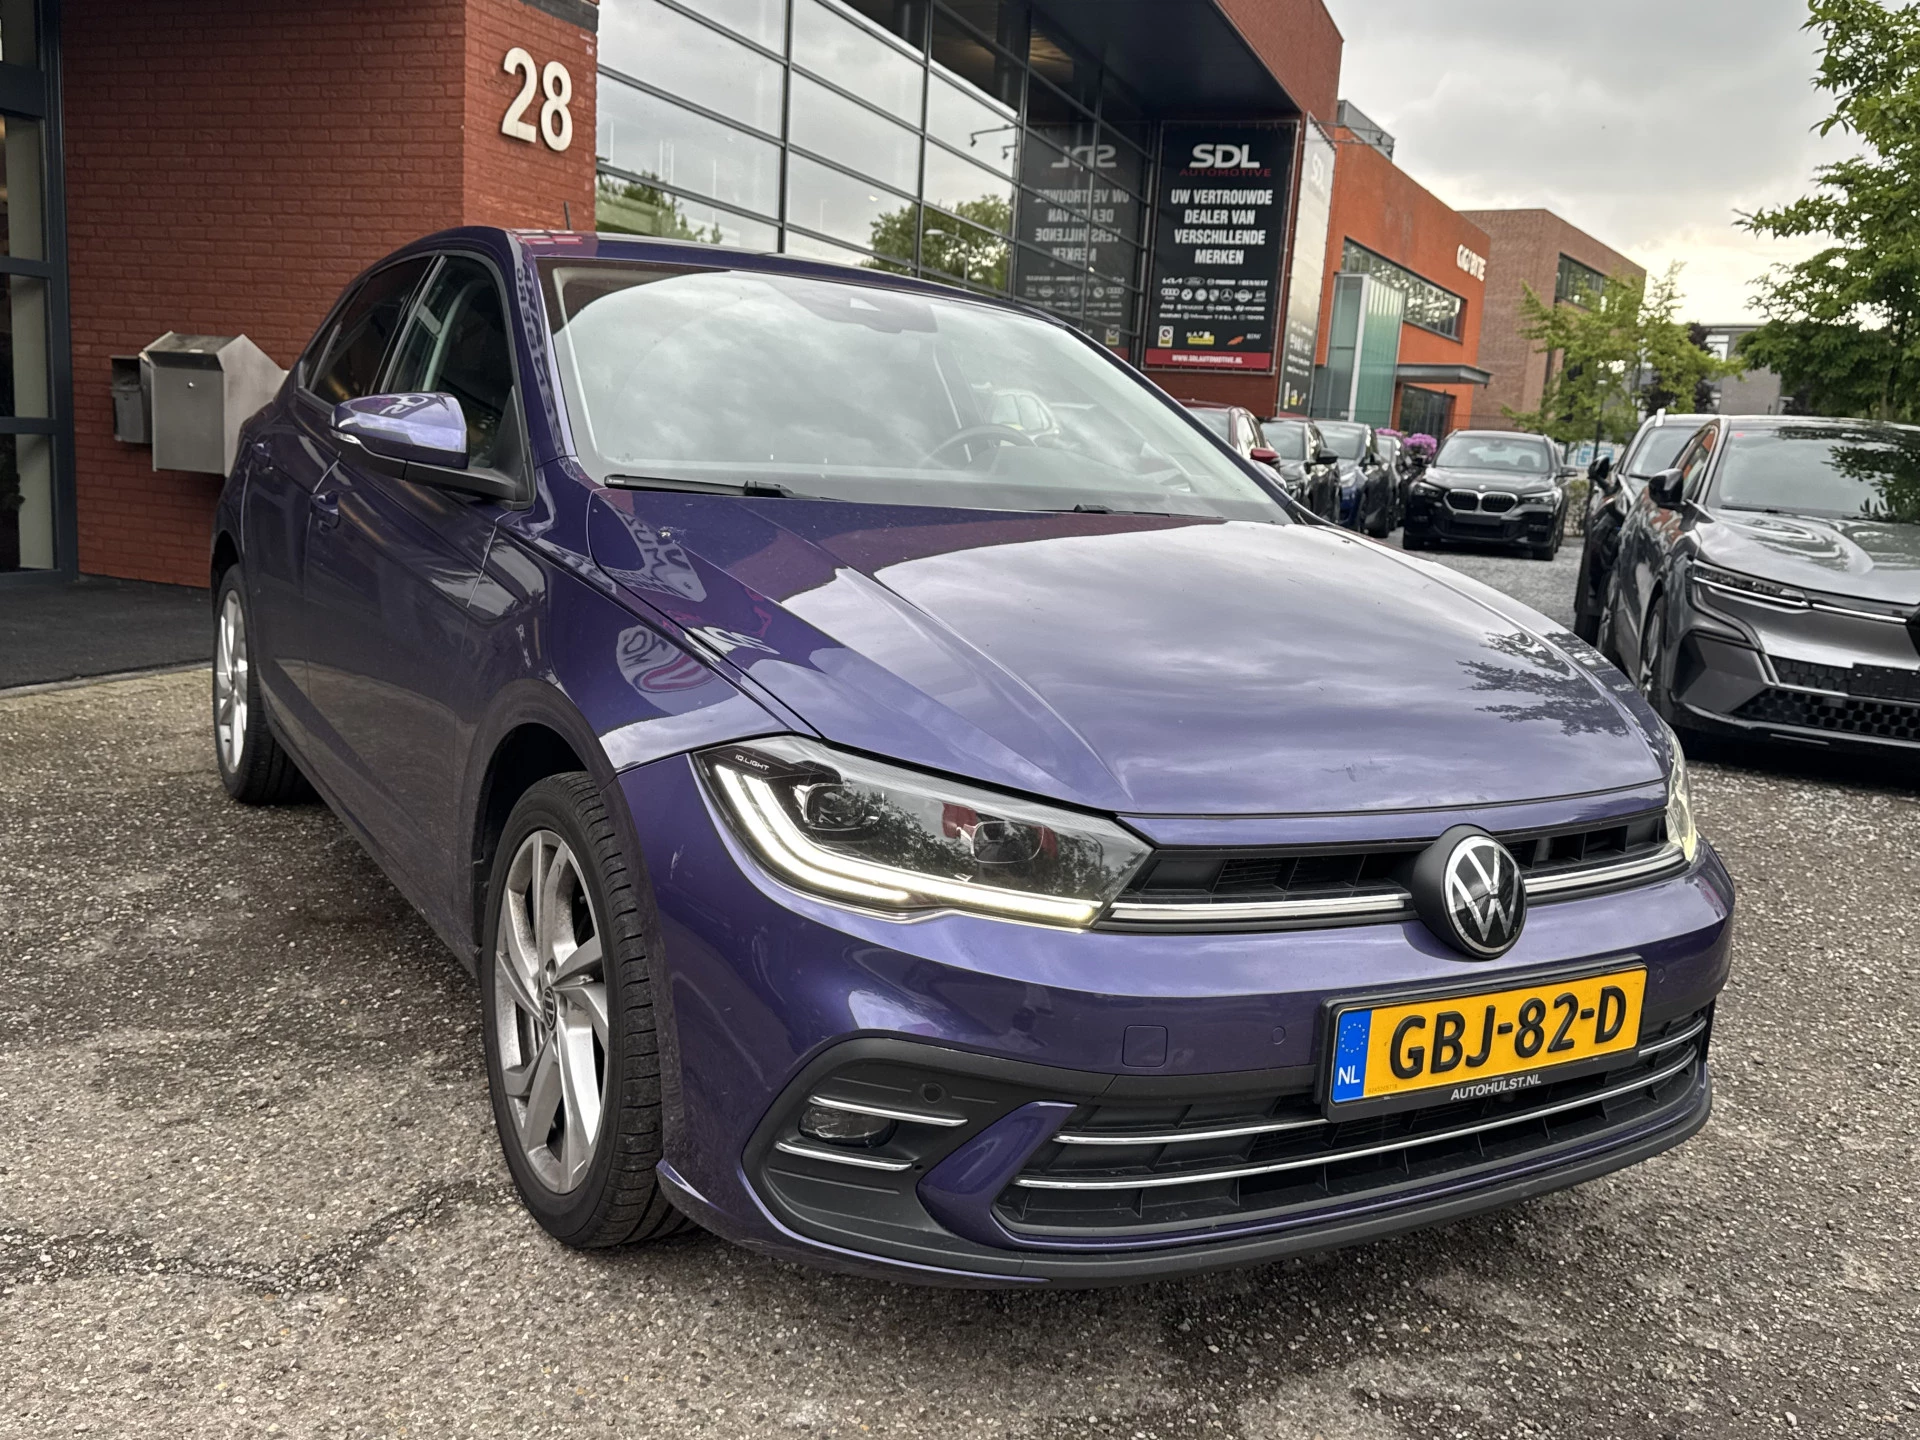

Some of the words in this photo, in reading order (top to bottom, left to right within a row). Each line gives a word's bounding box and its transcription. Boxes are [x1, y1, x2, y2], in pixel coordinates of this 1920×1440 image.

[501, 47, 573, 151] 28
[1189, 144, 1261, 168] SDL
[1179, 168, 1272, 177] AUTOMOTIVE
[1171, 189, 1190, 204] UW
[1193, 189, 1273, 205] VERTROUWDE
[1184, 209, 1228, 225] DEALER
[1232, 210, 1255, 225] VAN
[1174, 229, 1266, 245] VERSCHILLENDE
[1194, 249, 1244, 265] MERKEN
[1172, 354, 1243, 364] WWW.SDLAUTOMOTIVE.NL
[735, 754, 770, 771] IQ.LIGHT
[1389, 985, 1627, 1080] GBJ-82-D
[1337, 1066, 1360, 1087] NL
[1450, 1073, 1542, 1101] AUTOHULST.NL
